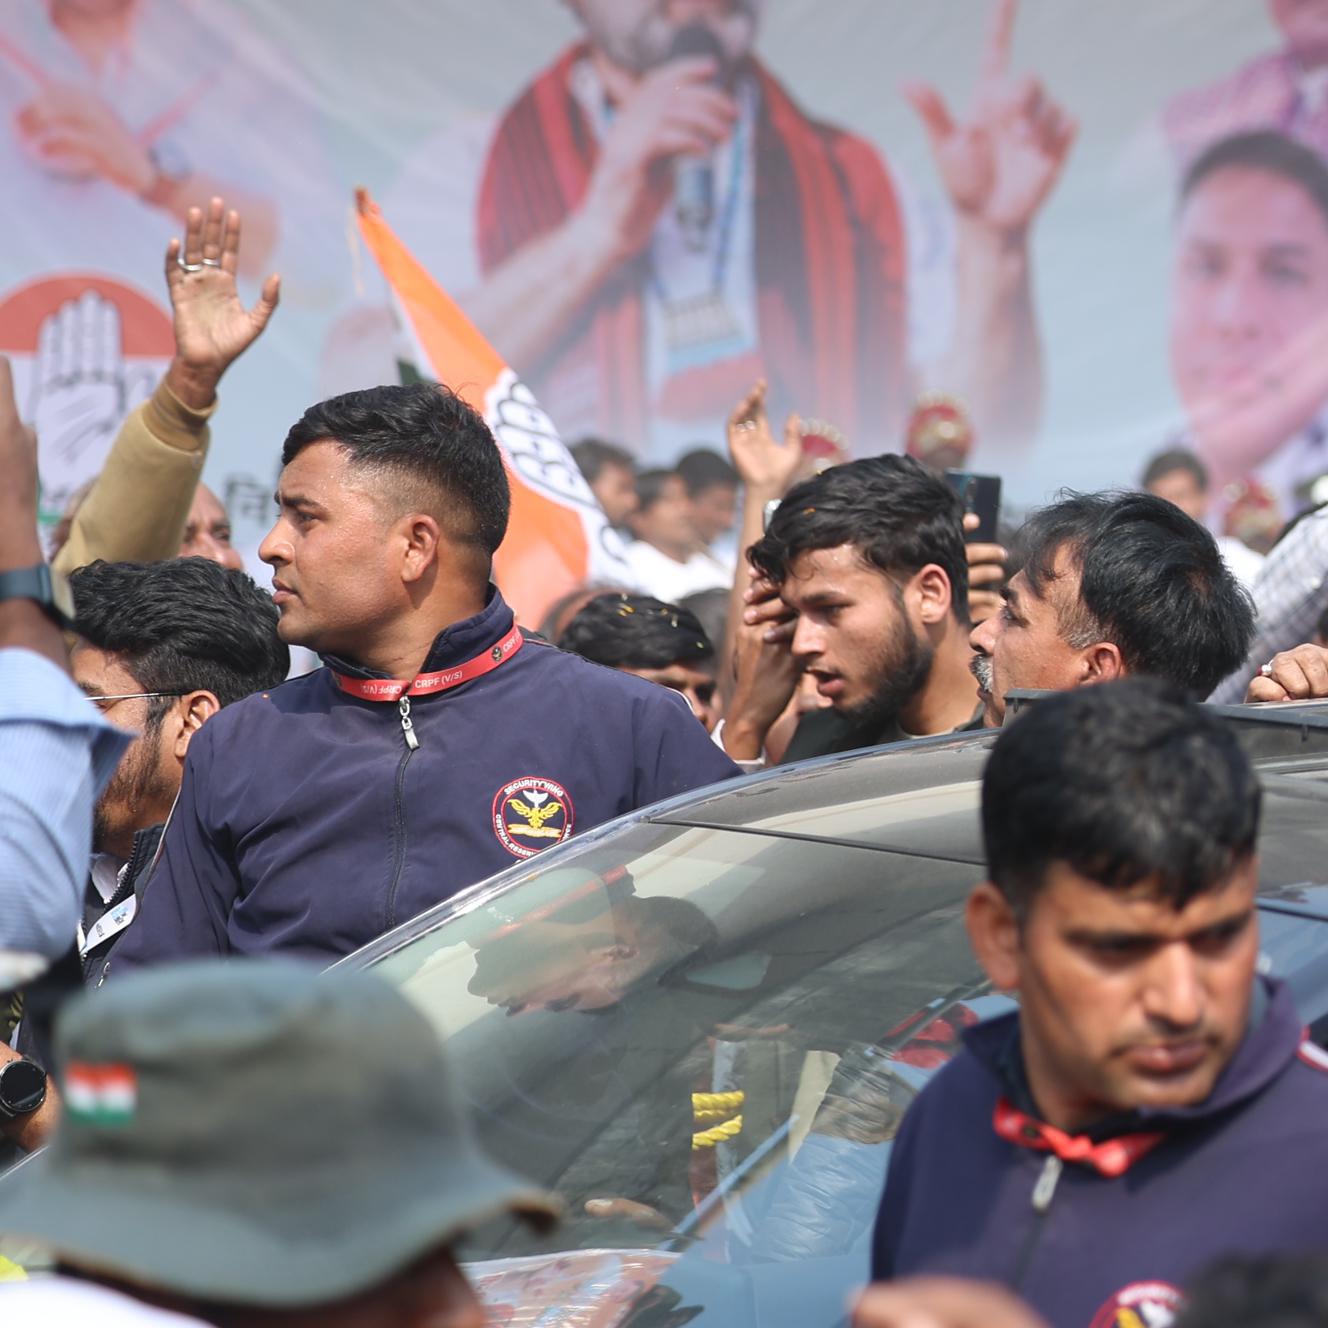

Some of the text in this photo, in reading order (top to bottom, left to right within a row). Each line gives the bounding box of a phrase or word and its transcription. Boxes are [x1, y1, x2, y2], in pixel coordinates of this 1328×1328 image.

[415, 671, 463, 689] CRPF (V/S)
[504, 780, 543, 795] SECURITY
